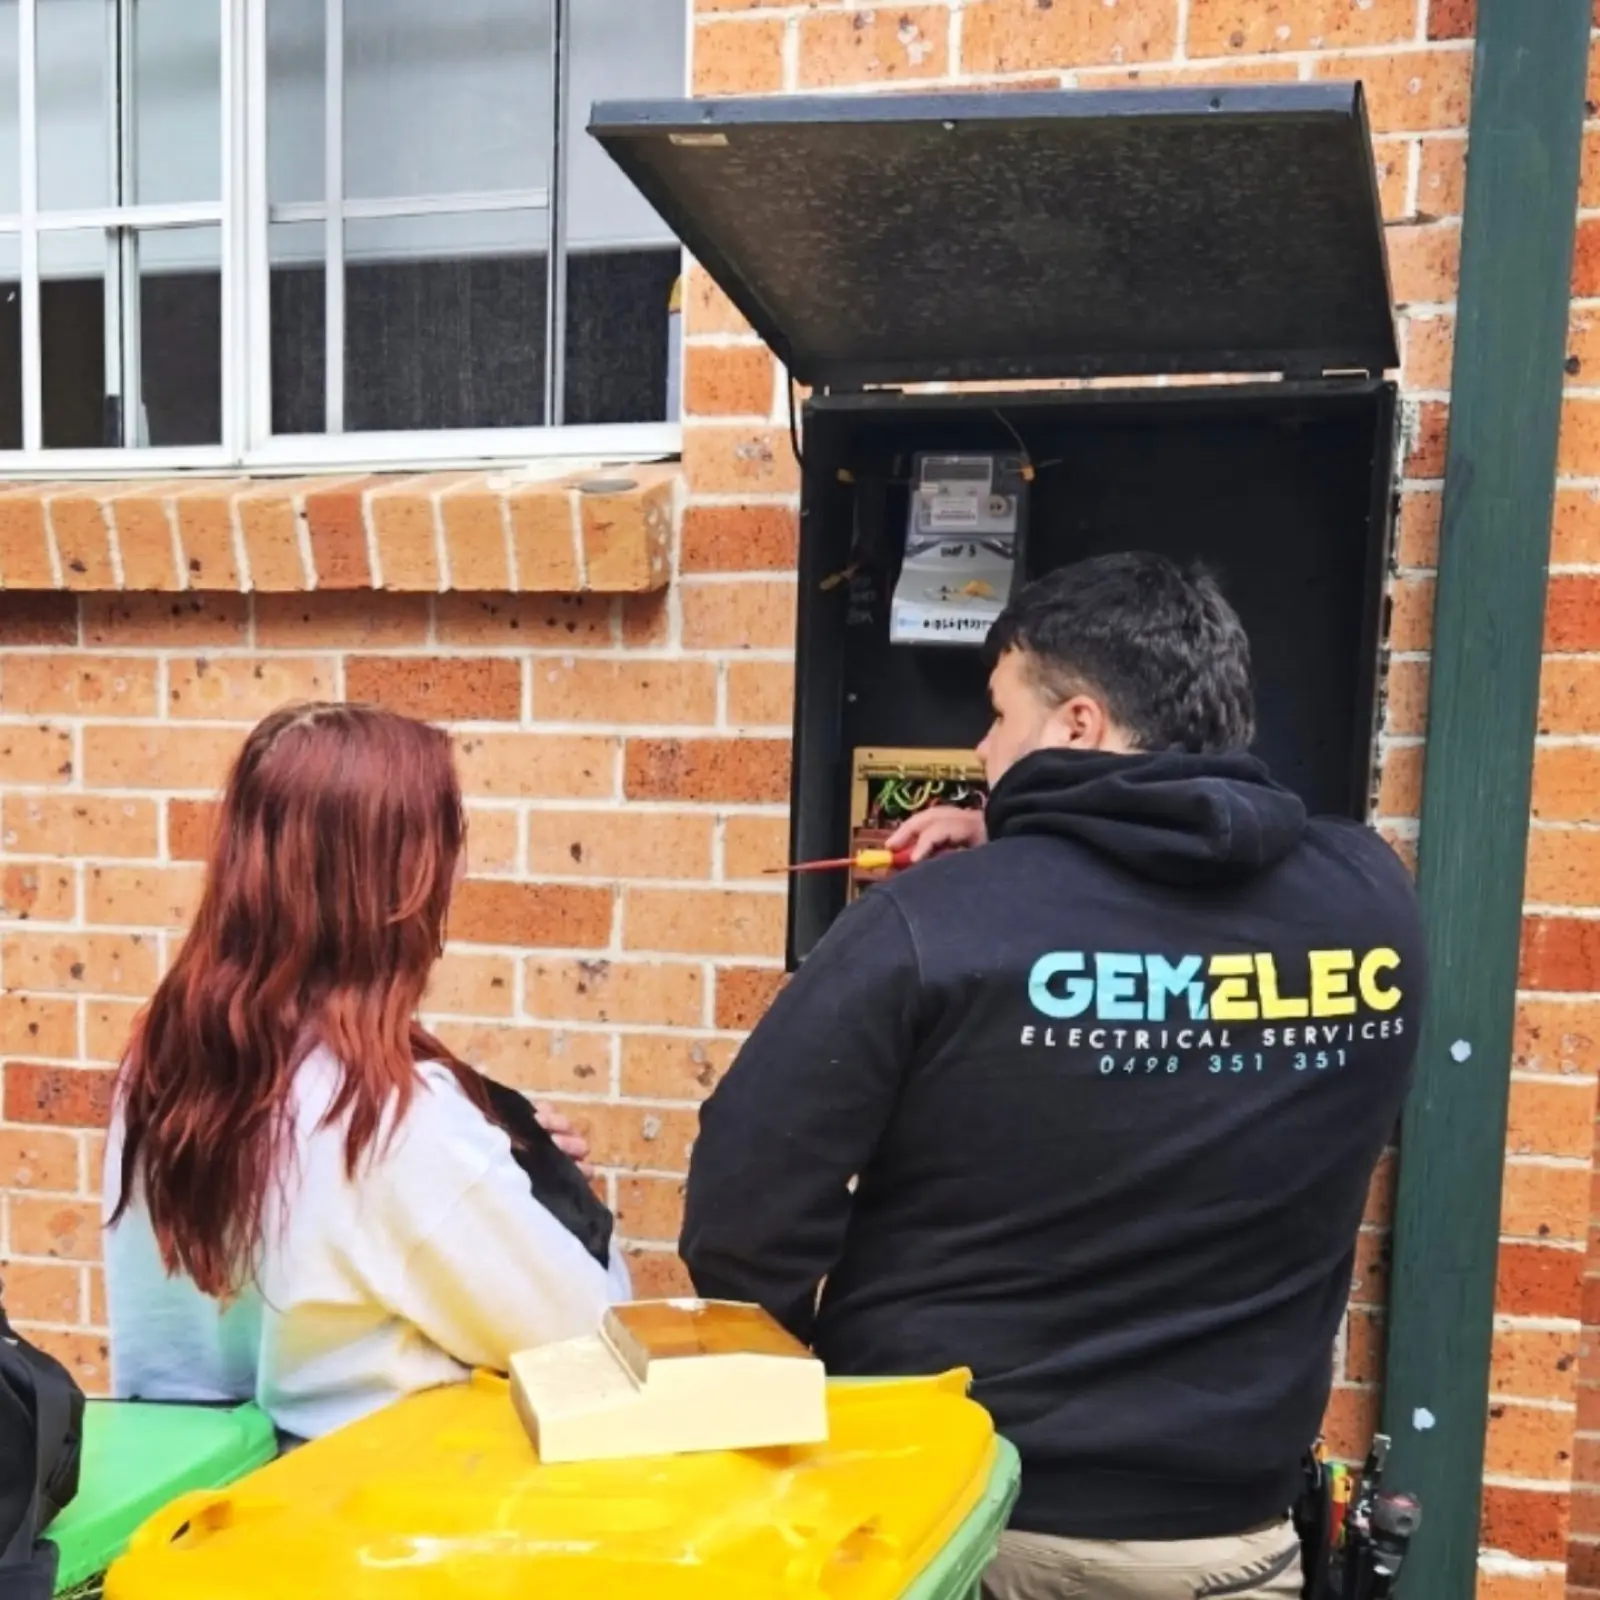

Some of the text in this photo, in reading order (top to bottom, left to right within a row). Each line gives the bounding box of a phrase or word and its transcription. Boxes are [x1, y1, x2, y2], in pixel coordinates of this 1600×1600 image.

[1028, 947, 1403, 1021] GEMELEC
[1020, 1018, 1404, 1049] ELECTRICAL SERVICES
[1099, 1049, 1346, 1074] 0498 351 351
